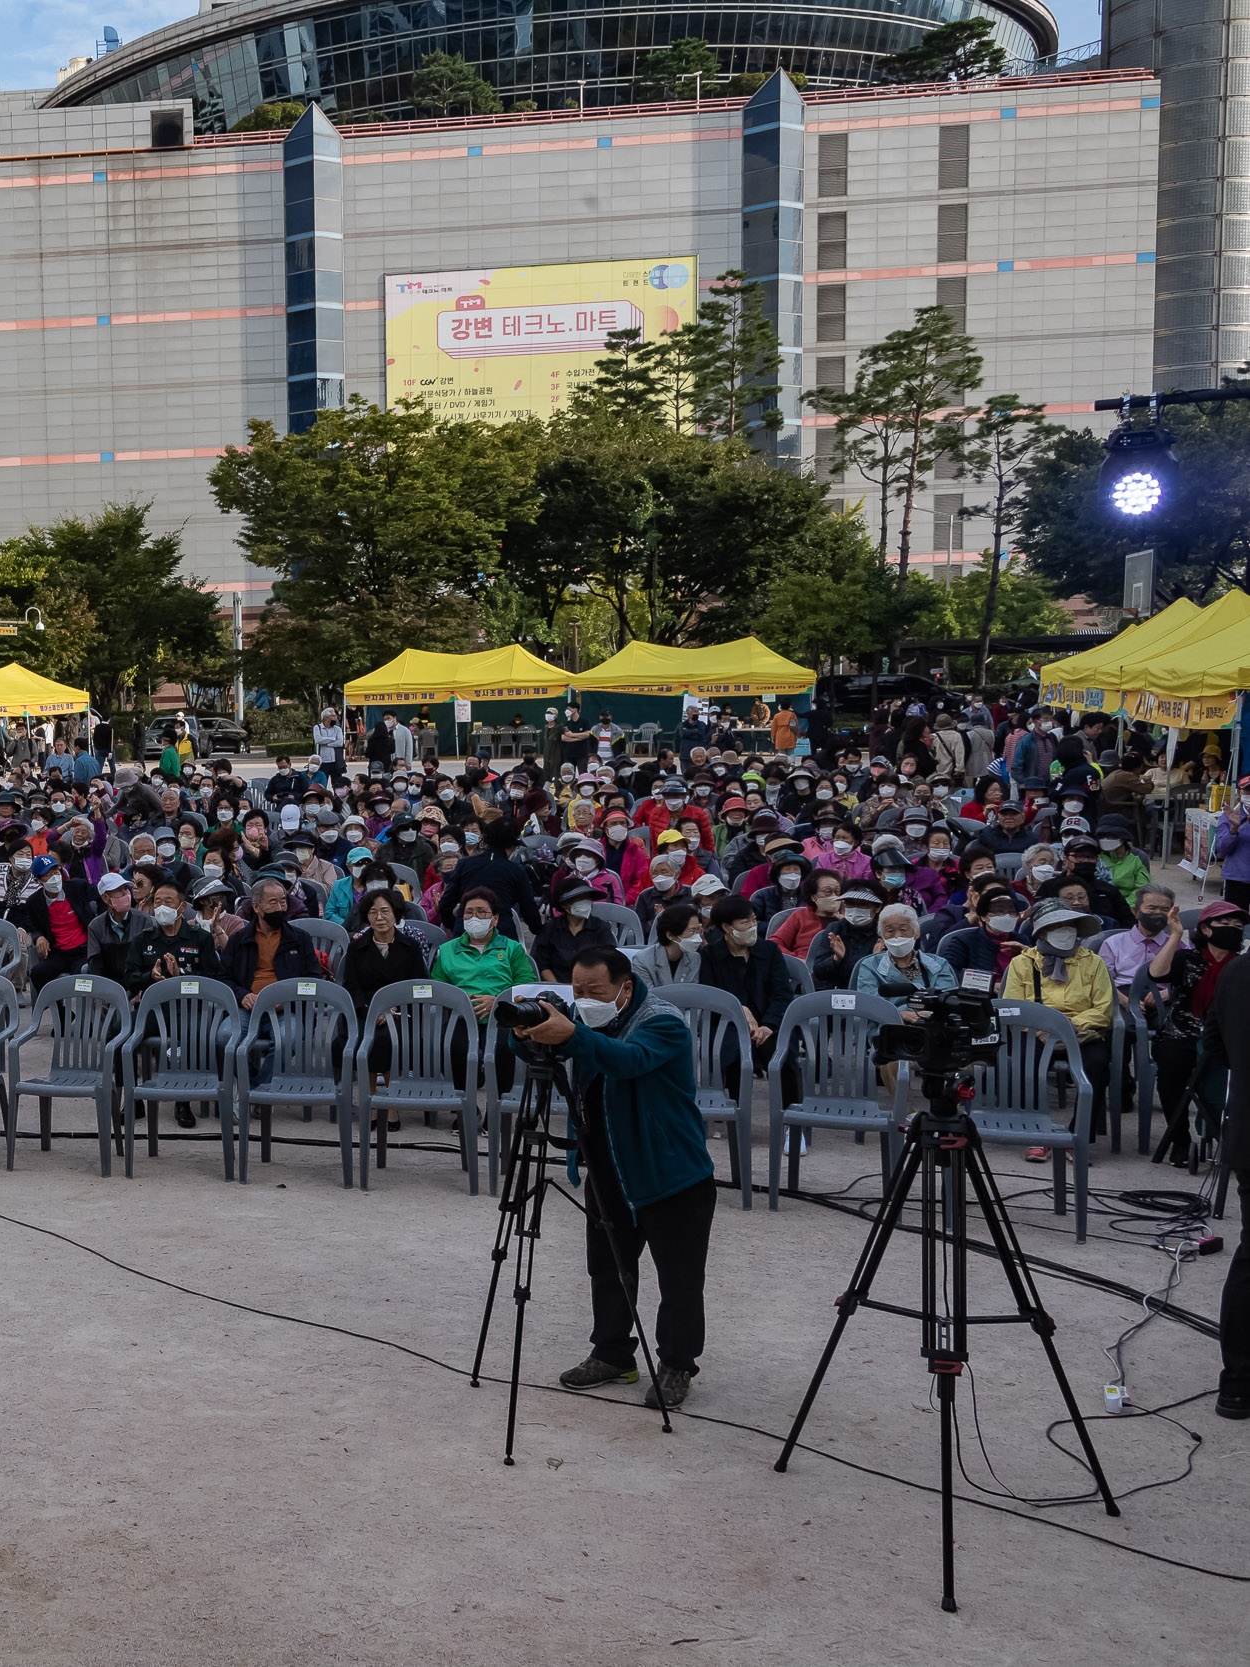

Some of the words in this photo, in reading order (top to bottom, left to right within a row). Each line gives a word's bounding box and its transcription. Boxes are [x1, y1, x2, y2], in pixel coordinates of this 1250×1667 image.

[460, 298, 481, 308] TM
[451, 317, 492, 340] 강변
[503, 310, 617, 336] 테크노.마트
[566, 368, 595, 377] 수입가전
[403, 379, 416, 387] 10F
[440, 377, 454, 385] 강변
[420, 390, 456, 398] 전문식당가
[464, 387, 493, 396] 하늘공원
[449, 401, 466, 409] DVD
[474, 399, 495, 408] 게임기
[473, 410, 502, 419] 사무기기
[697, 685, 730, 693] 도시양봉
